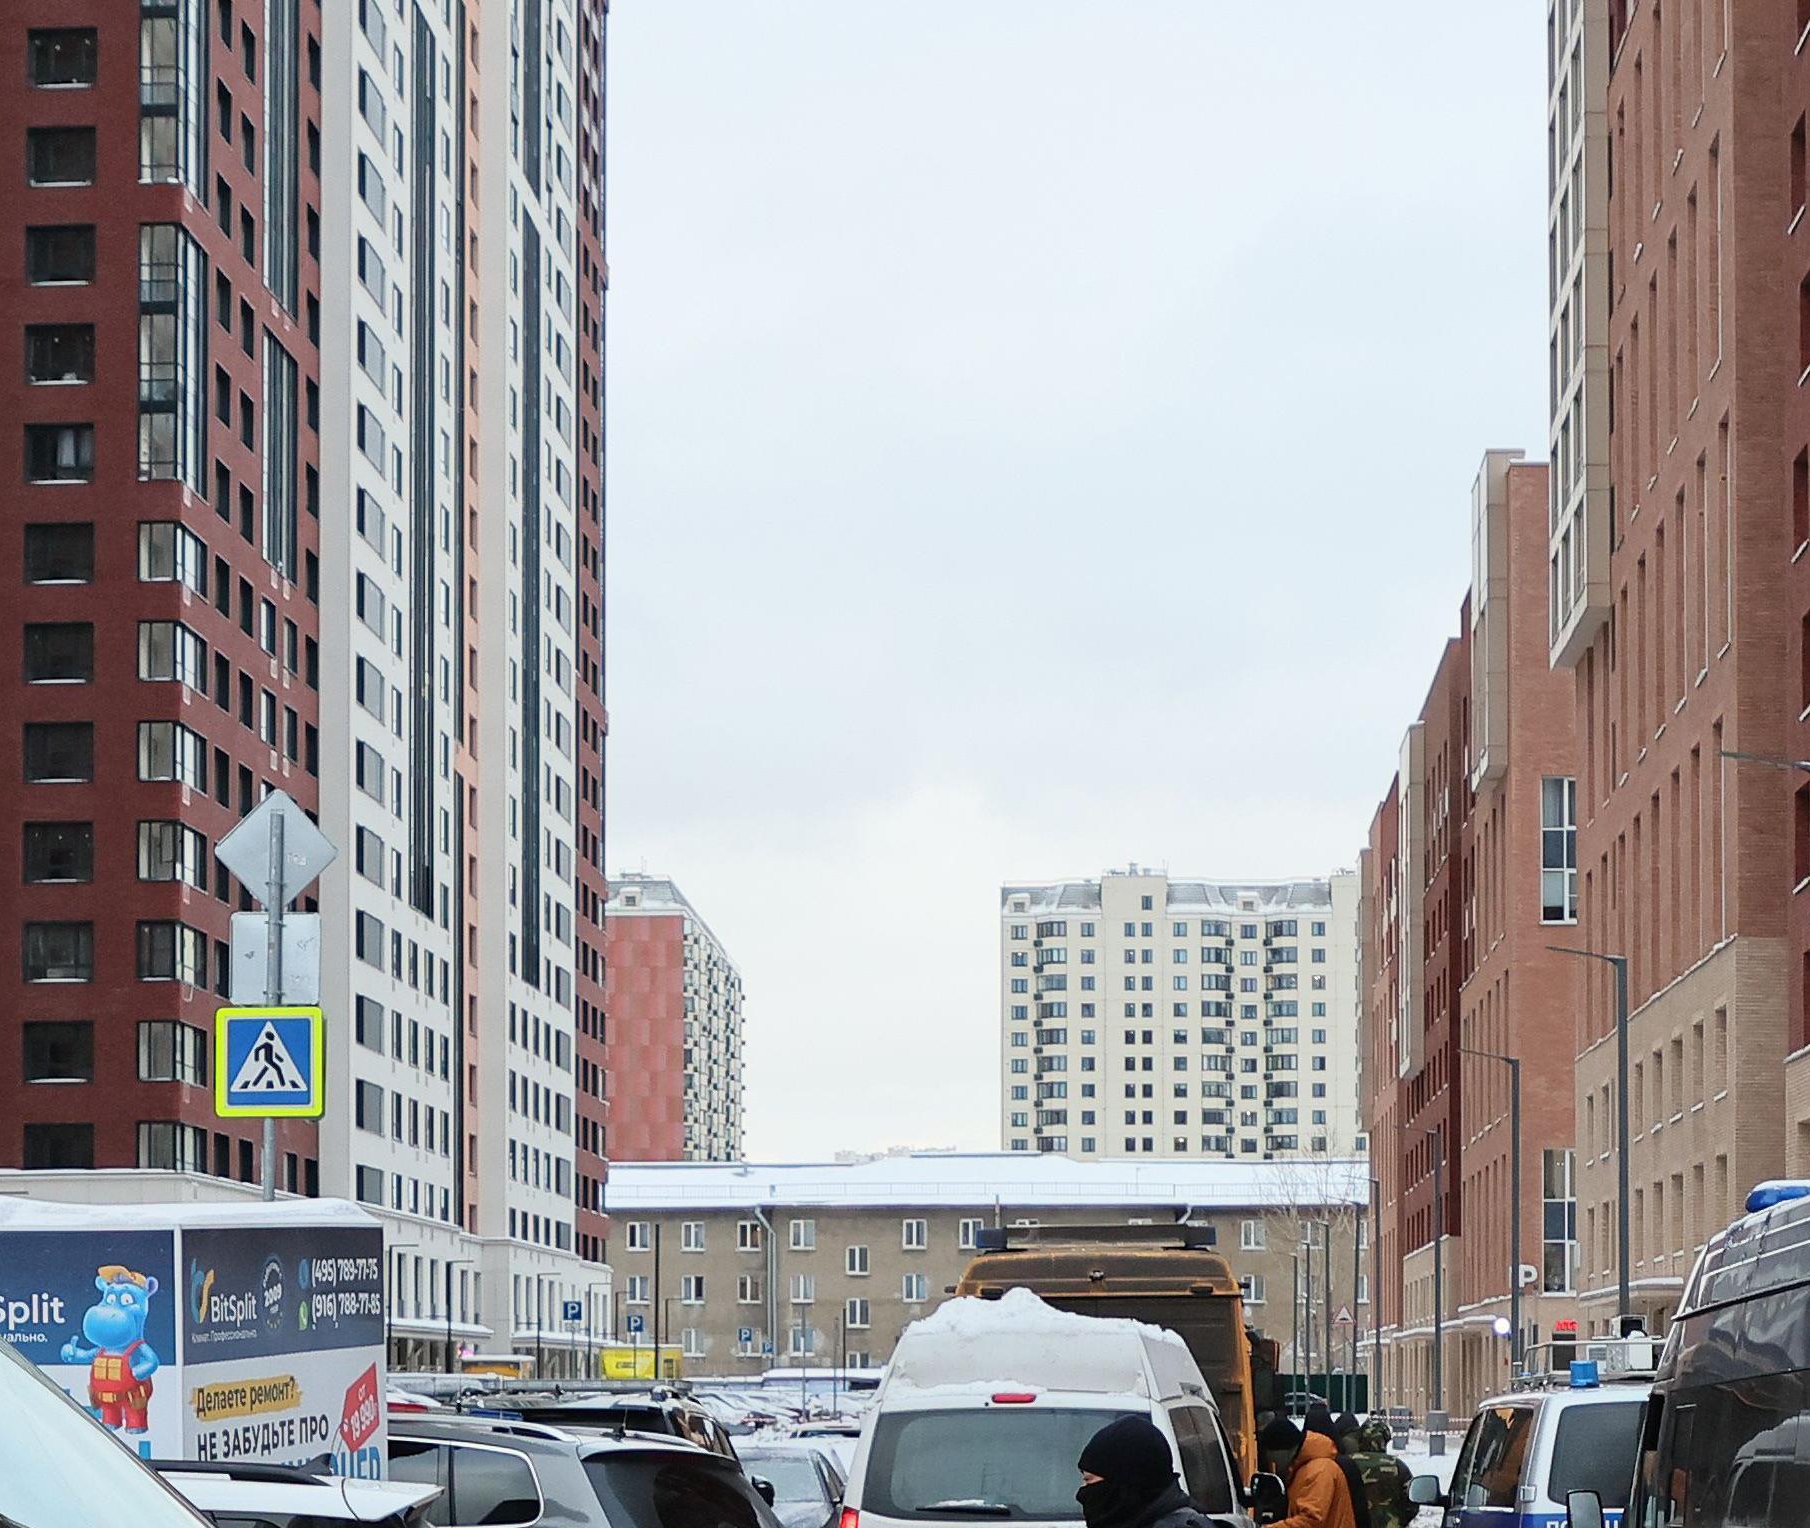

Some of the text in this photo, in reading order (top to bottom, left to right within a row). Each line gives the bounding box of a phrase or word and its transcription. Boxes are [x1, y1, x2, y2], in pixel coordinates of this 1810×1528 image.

[312, 1258, 337, 1288] (495)
[211, 1292, 257, 1327] BitSplit
[264, 1283, 282, 1307] 2009
[312, 1293, 337, 1323] (916)
[196, 1375, 296, 1418] Делаете ремонт?
[197, 1413, 329, 1462] НЕ ЗАБУДЬТЕ ПРО
